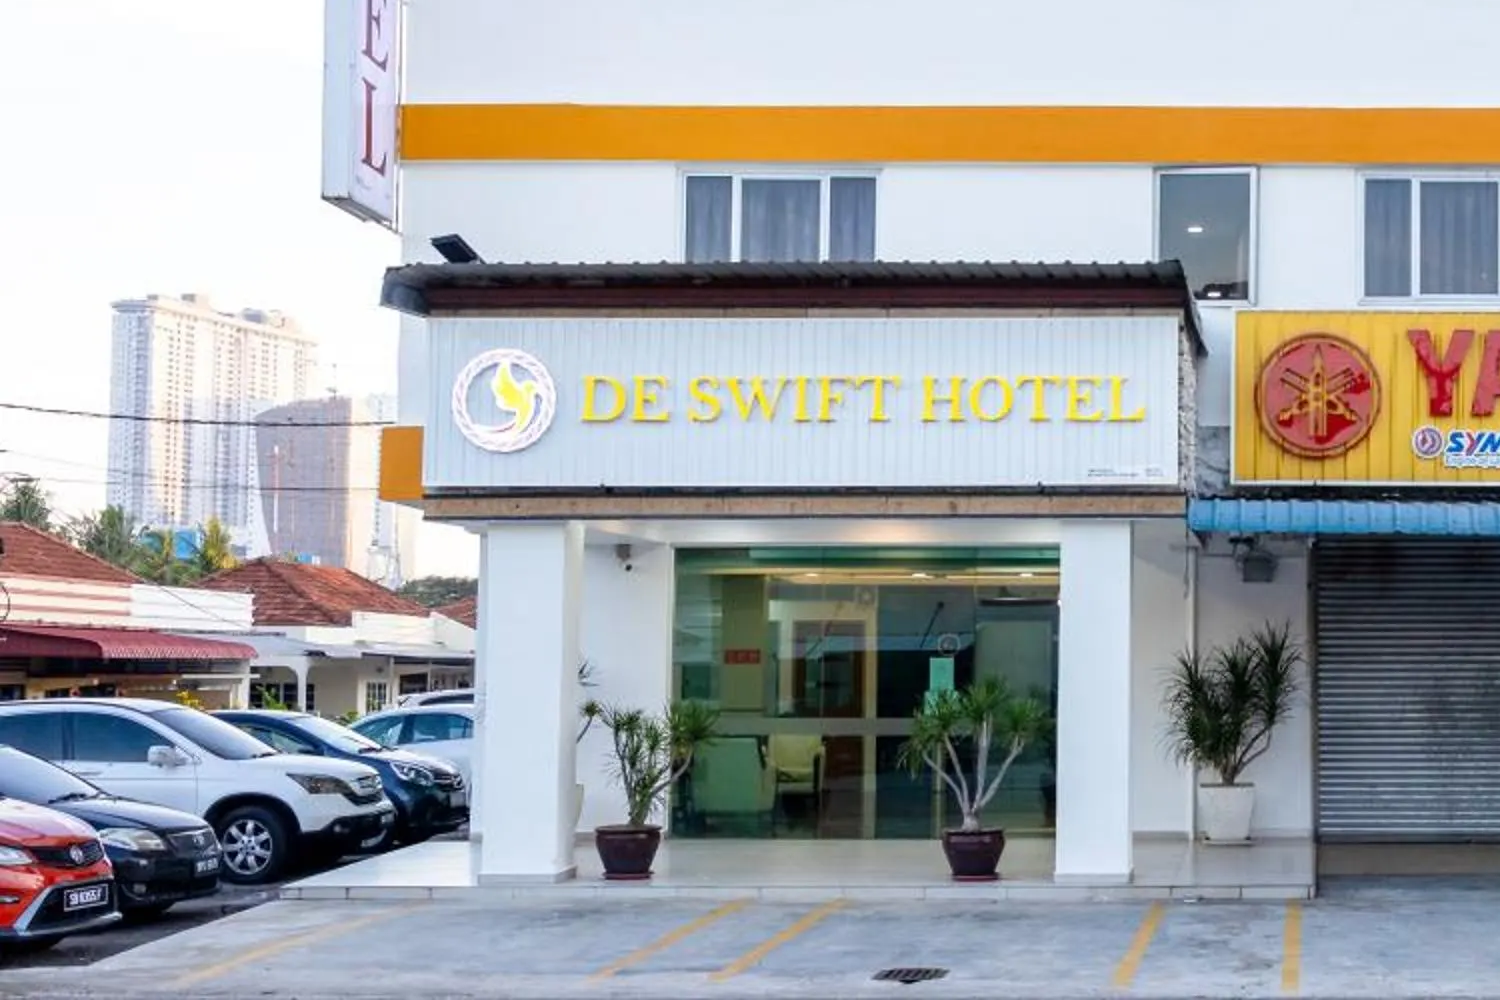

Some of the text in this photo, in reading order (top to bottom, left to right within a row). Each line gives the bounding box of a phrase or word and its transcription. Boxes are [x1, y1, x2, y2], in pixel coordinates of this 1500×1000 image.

[580, 375, 1146, 423] DE SWIFT HOTEL
